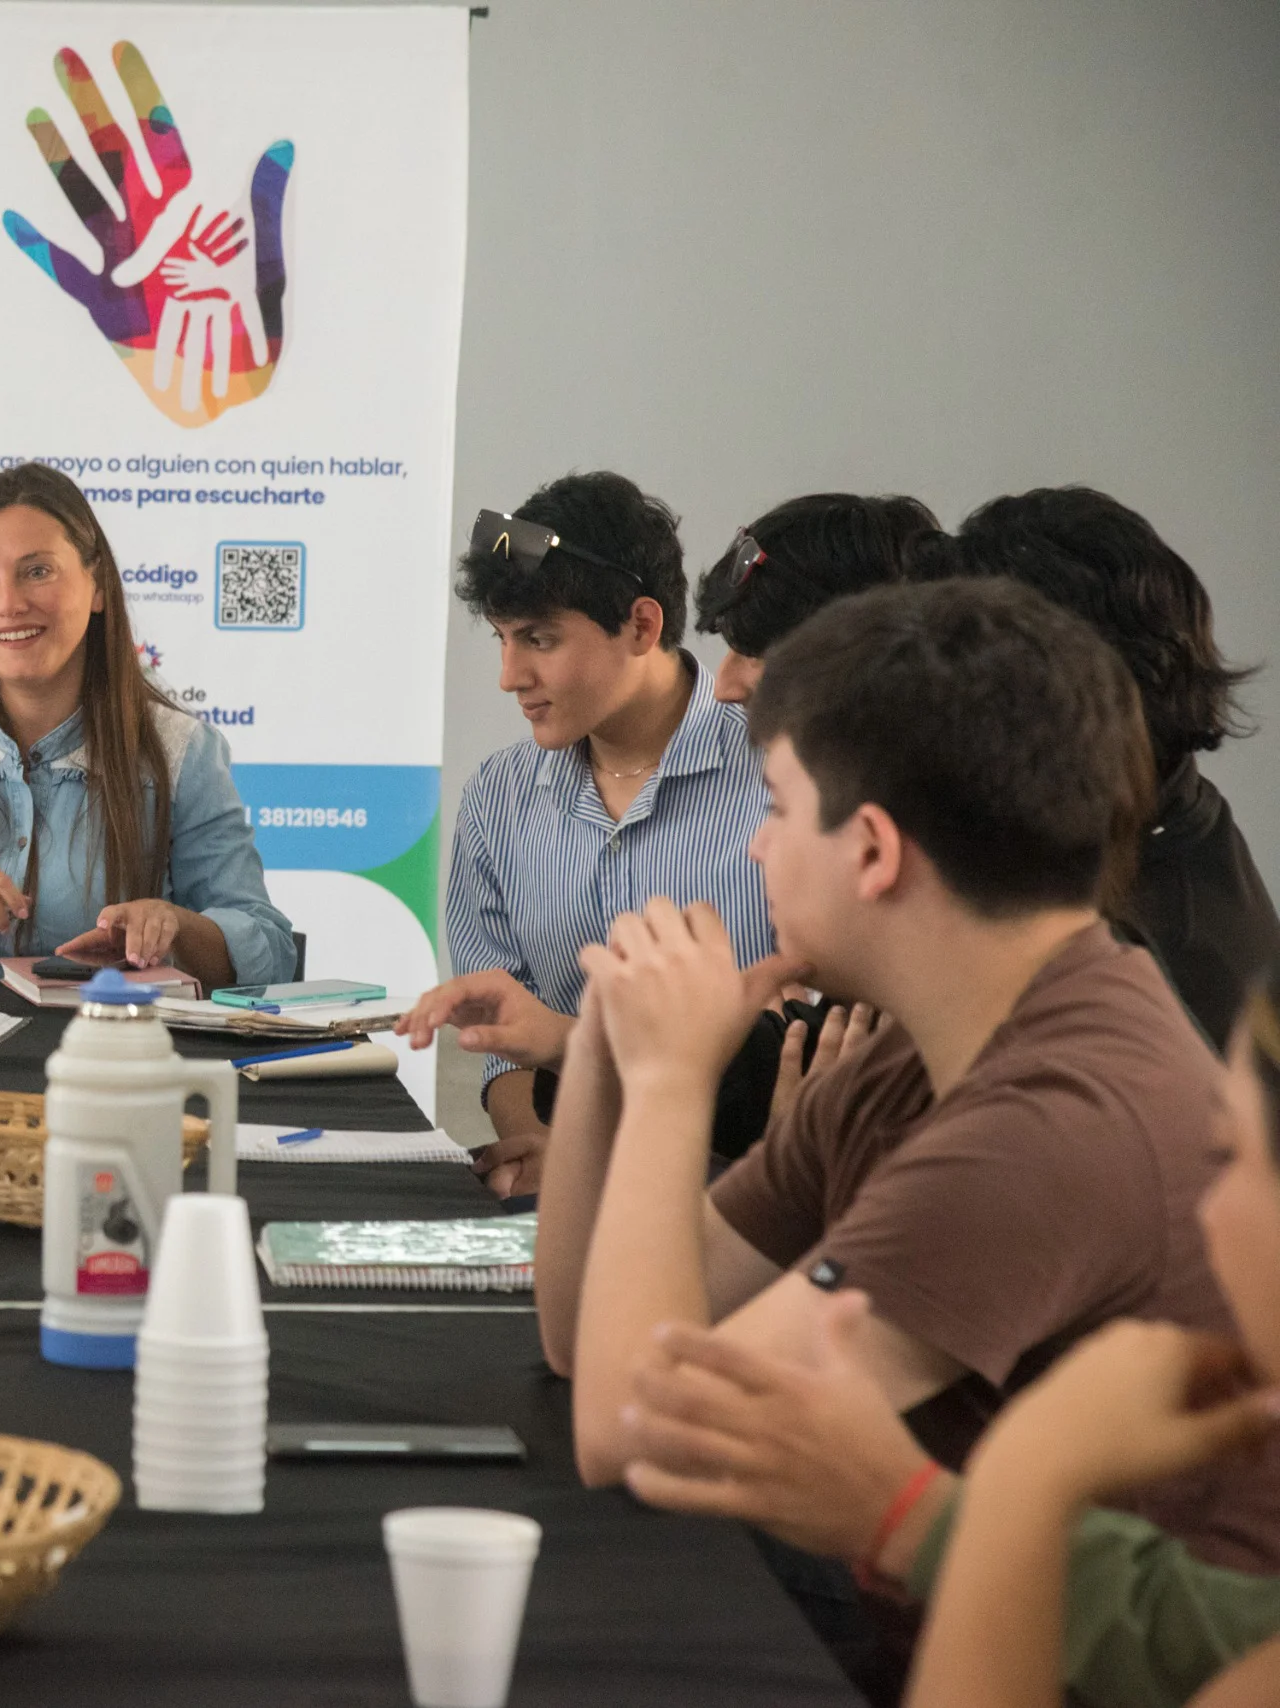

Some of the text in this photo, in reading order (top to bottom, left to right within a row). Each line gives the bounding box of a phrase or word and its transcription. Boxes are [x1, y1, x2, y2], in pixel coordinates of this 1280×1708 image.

[107, 459, 120, 473] o
[126, 454, 210, 479] alguien
[214, 460, 256, 475] con
[261, 456, 324, 481] quien
[329, 457, 408, 479] hablar,
[83, 486, 326, 509] mos para escucharte
[122, 563, 198, 590] código
[182, 686, 207, 702] de
[195, 705, 256, 725] ntud
[259, 806, 368, 828] 381219546
